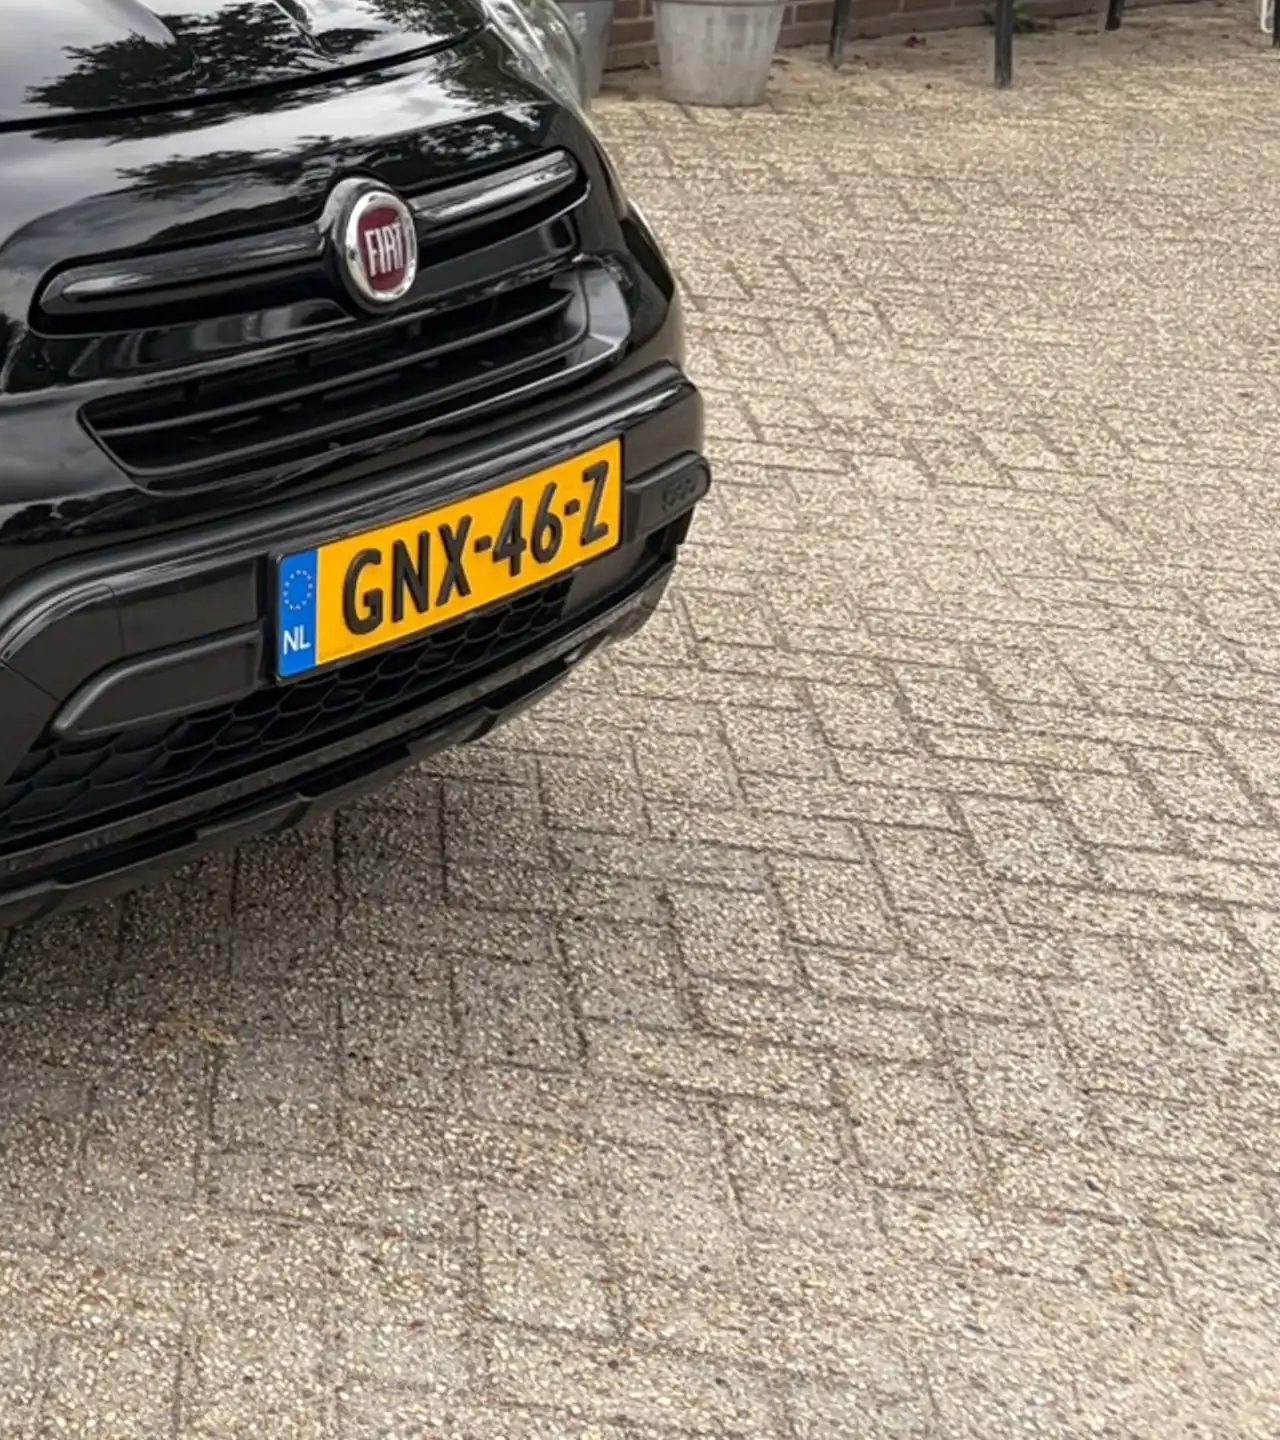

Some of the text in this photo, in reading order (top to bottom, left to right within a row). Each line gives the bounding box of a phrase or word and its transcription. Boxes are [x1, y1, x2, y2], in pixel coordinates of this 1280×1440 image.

[363, 220, 406, 277] FIAT
[341, 460, 610, 636] GNX-46-Z
[283, 626, 312, 656] NL
